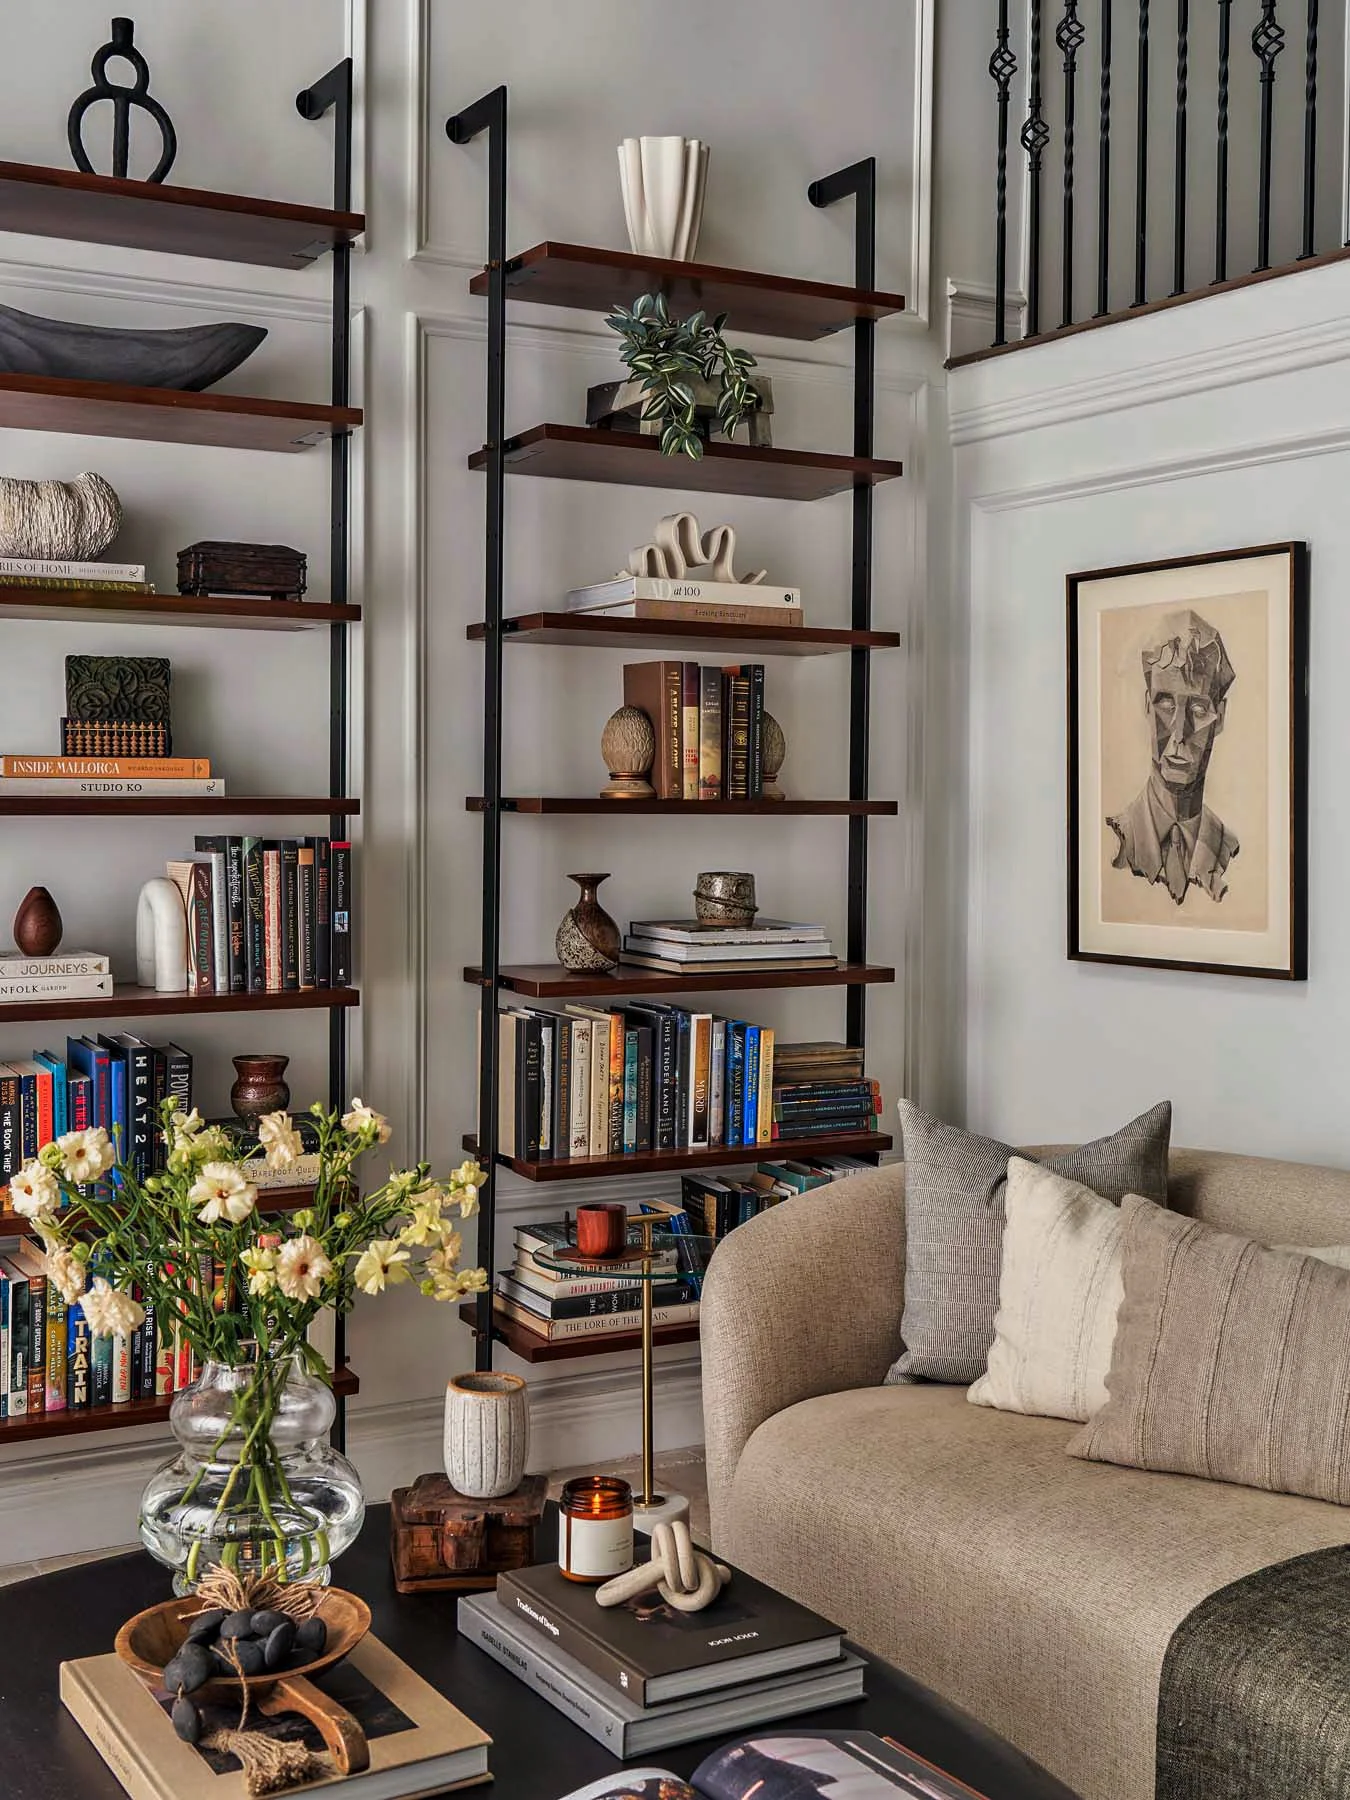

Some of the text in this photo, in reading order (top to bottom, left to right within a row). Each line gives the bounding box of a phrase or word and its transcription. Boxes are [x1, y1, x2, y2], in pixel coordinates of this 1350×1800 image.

[24, 563, 38, 572] OF
[41, 564, 72, 575] HOME
[673, 586, 682, 596] at
[683, 587, 701, 598] 100
[671, 697, 679, 728] BLAZE
[671, 737, 679, 769] GLORY
[13, 760, 53, 773] INSIDE
[57, 761, 120, 774] MALLORCA
[80, 783, 142, 793] STUDIO KO
[198, 899, 210, 973] GREENWOOD
[21, 963, 88, 976] JOURNEYS
[1, 1081, 9, 1105] ZUSAK
[8, 1080, 16, 1106] MARKUS
[135, 1056, 147, 1144] HEAT 2
[695, 1079, 705, 1113] MADRID
[29, 1112, 35, 1121] OF
[610, 1101, 619, 1138] MARTIN
[627, 1107, 635, 1125] YOU
[732, 1098, 741, 1128] PERRY
[3, 1111, 13, 1173] THE BOOK THIEF
[589, 1280, 616, 1292] ATLANTIC
[617, 1279, 632, 1289] ADAM
[611, 1293, 619, 1313] WOK
[34, 1308, 42, 1323] BOOK
[565, 1314, 640, 1333] THE LORE OF THE
[145, 1317, 153, 1337] RISE
[33, 1328, 41, 1363] SPECULATION
[73, 1320, 88, 1404] TRAIN
[119, 1350, 128, 1367] JOHN
[516, 1597, 540, 1621] Traditions
[543, 1614, 560, 1636] Design
[480, 1630, 502, 1651] ISABELLE
